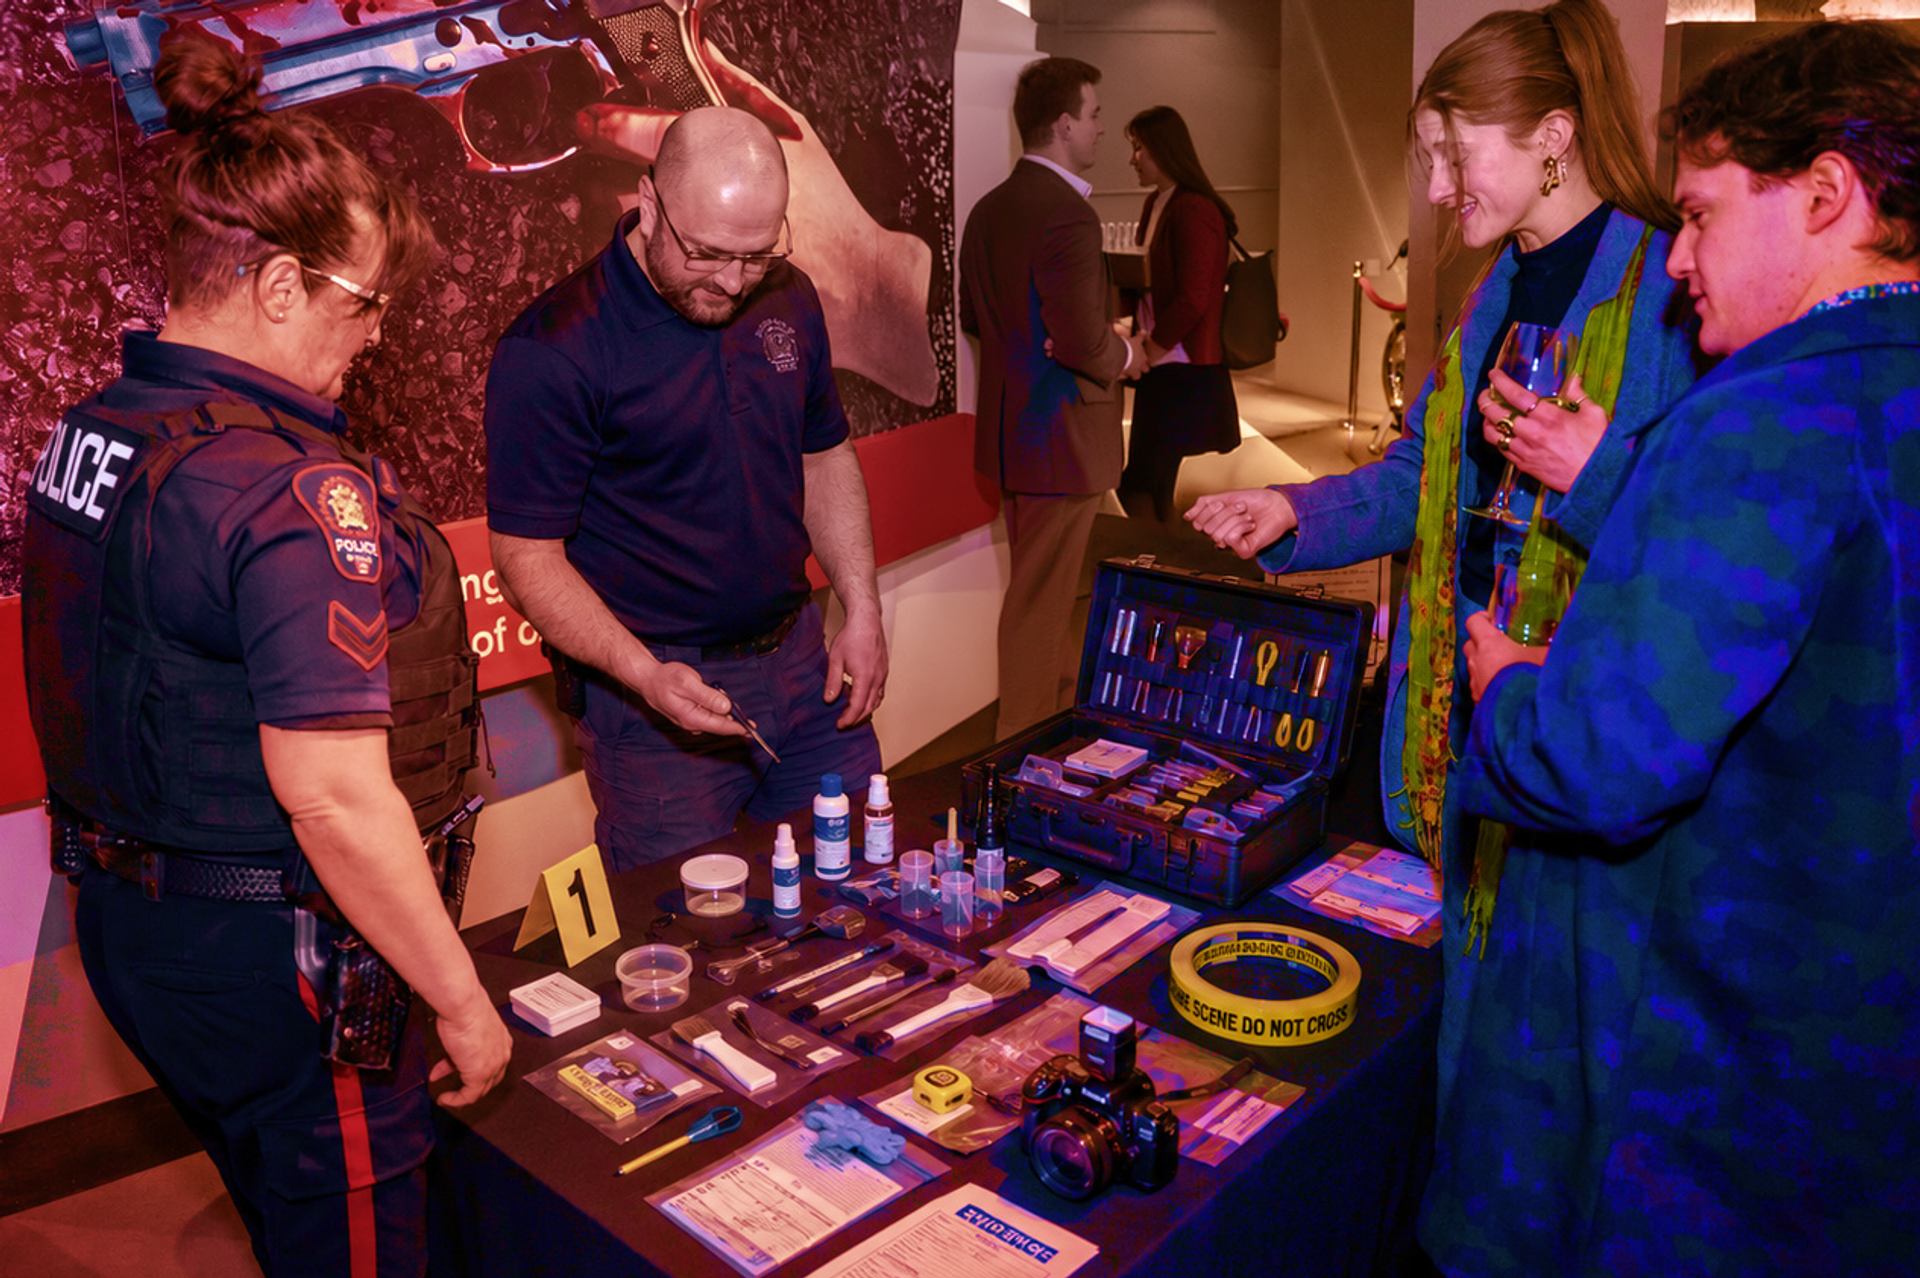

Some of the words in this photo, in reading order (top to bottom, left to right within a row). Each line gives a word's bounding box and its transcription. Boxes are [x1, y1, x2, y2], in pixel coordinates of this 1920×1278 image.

[472, 615, 507, 658] of
[567, 867, 597, 938] 1
[1192, 999, 1238, 1032] SCENE
[1241, 1016, 1266, 1037] DO
[1269, 1018, 1304, 1038] NOT
[1307, 1004, 1349, 1035] CROSS
